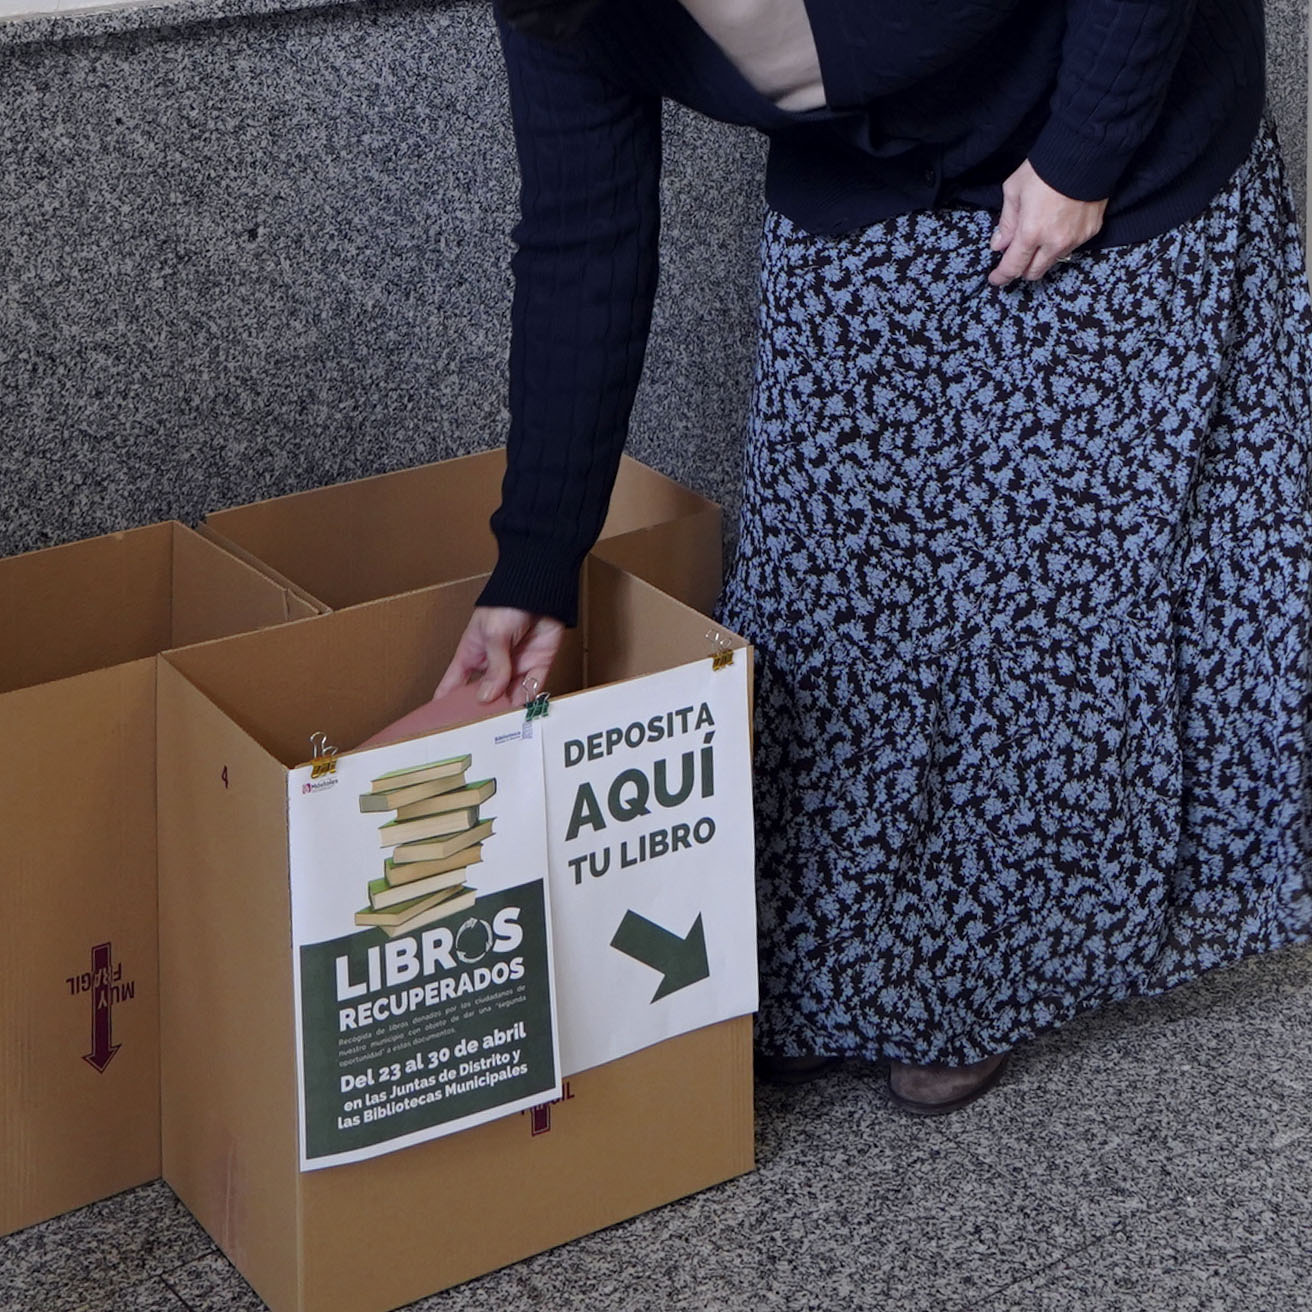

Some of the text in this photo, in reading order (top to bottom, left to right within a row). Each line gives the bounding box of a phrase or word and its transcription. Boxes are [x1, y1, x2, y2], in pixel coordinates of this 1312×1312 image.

[564, 701, 715, 768] DEPOSITA
[564, 730, 715, 842] AQUÍ
[567, 817, 717, 885] TU LIBRO
[335, 906, 523, 1002] LIBROS
[97, 981, 135, 1010] MUY
[338, 1031, 372, 1046] Recogida
[388, 1021, 409, 1032] libros
[412, 1011, 442, 1025] donados
[474, 989, 514, 1005] ciudadanos
[339, 957, 525, 1032] RECUPERADOS
[339, 1045, 366, 1056] nuestro
[341, 1021, 527, 1092] Del 23 al 30 de abril
[344, 1049, 521, 1112] en las Juntas de Distrito y
[338, 1114, 361, 1130] las
[363, 1088, 443, 1124] Bibliotecas
[445, 1062, 528, 1099] Municipales
